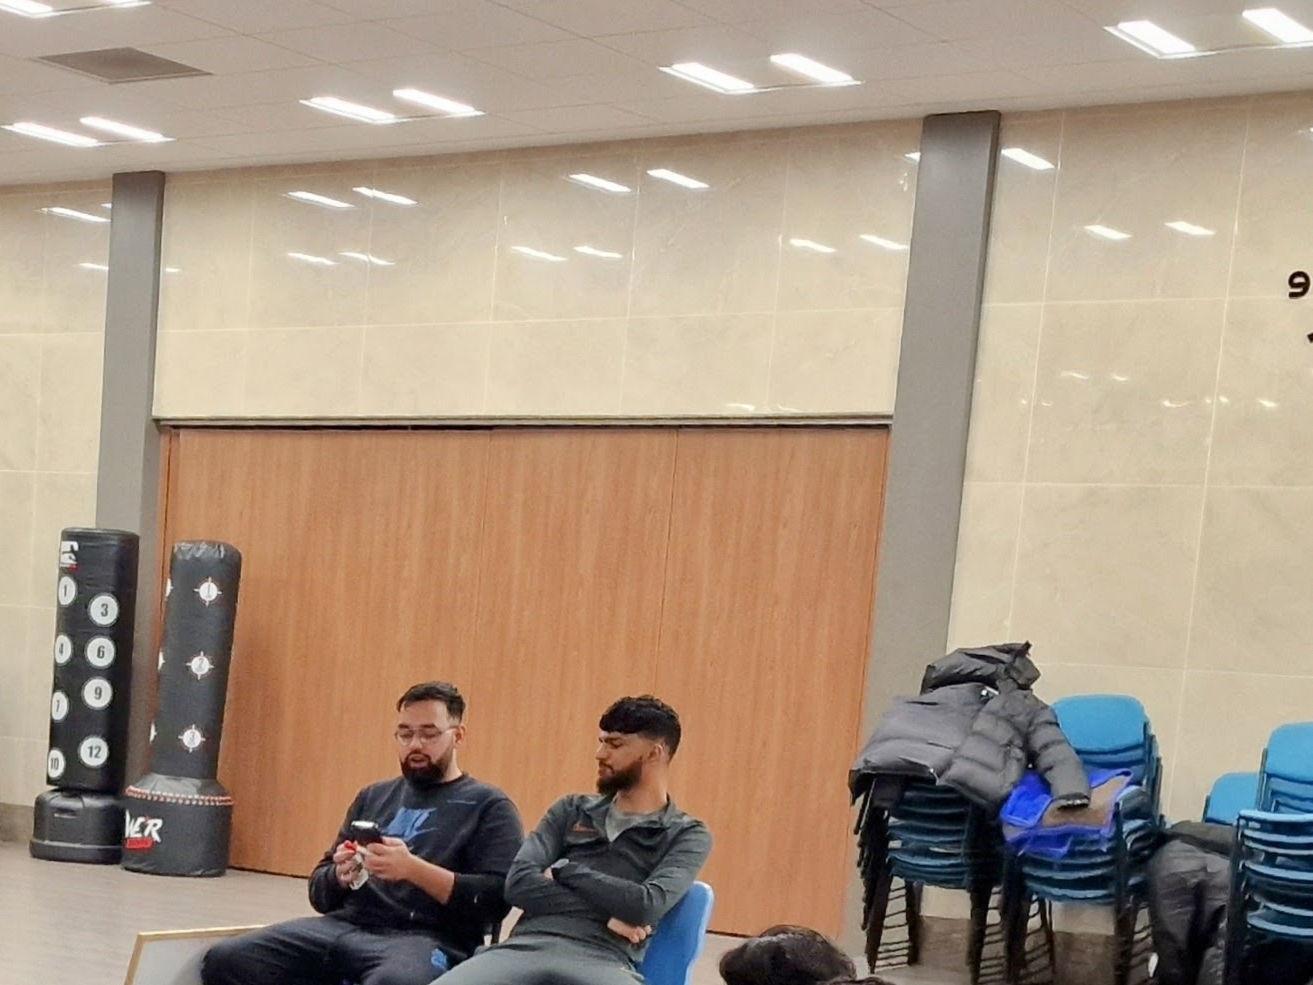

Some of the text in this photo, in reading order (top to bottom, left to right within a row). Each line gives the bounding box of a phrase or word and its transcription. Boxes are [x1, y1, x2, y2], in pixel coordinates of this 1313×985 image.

[1287, 270, 1311, 299] 9
[100, 603, 109, 617] 3
[96, 644, 106, 659] 6
[93, 686, 103, 701] 9
[87, 745, 102, 759] 12
[49, 757, 60, 771] 10
